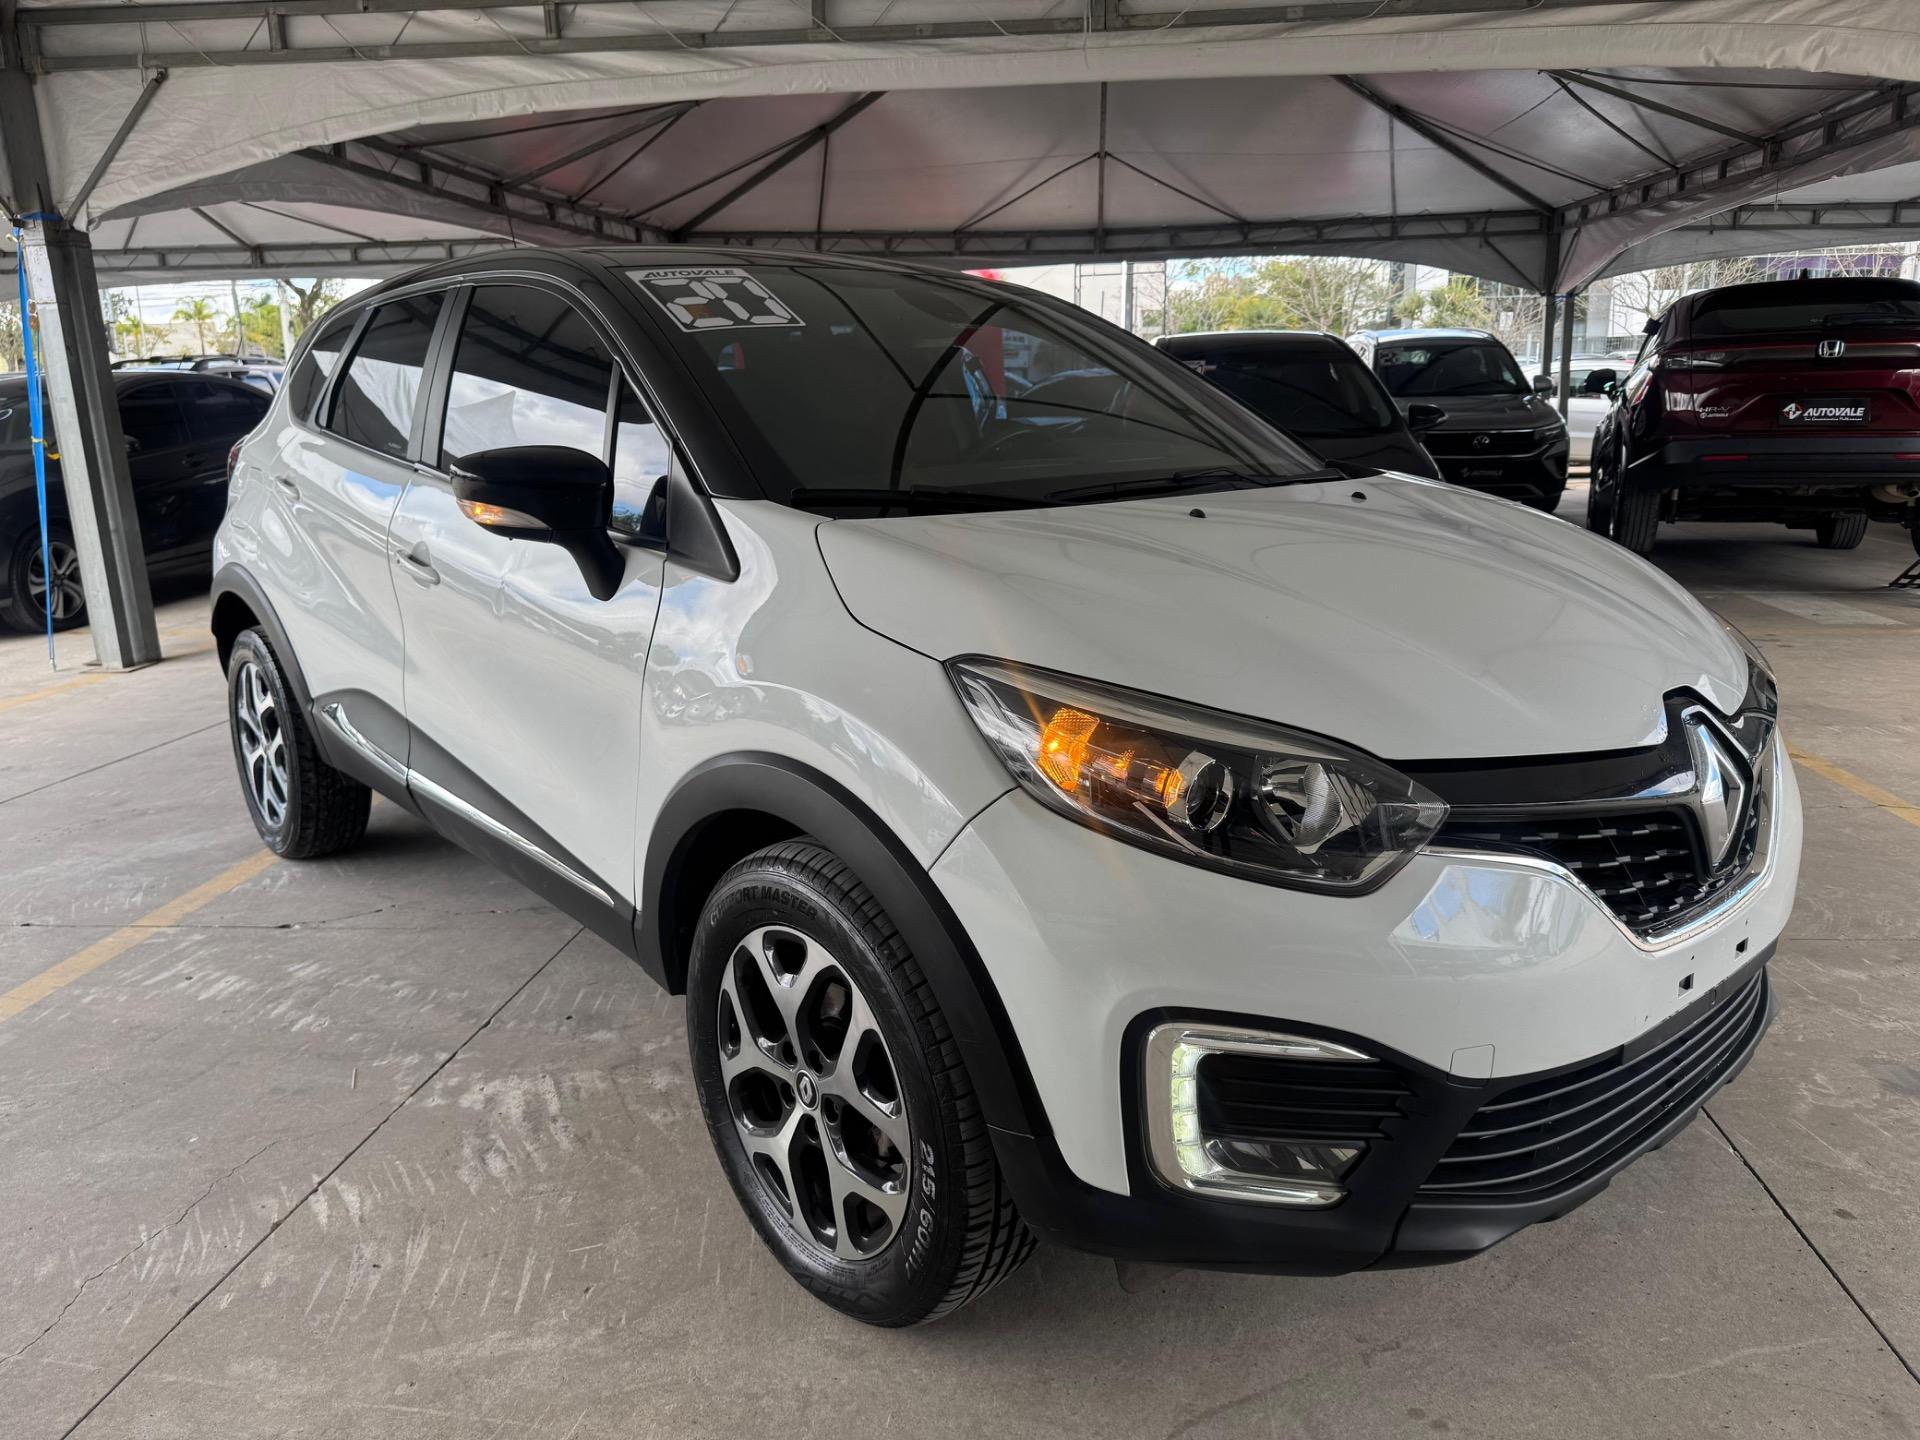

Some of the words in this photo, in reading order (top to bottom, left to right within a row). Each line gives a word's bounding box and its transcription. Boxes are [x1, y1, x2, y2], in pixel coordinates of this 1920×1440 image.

[643, 269, 737, 279] AUTOVALE
[650, 276, 792, 328] 20
[1803, 407, 1866, 417] AUTOVALE
[760, 885, 818, 921] MASTER
